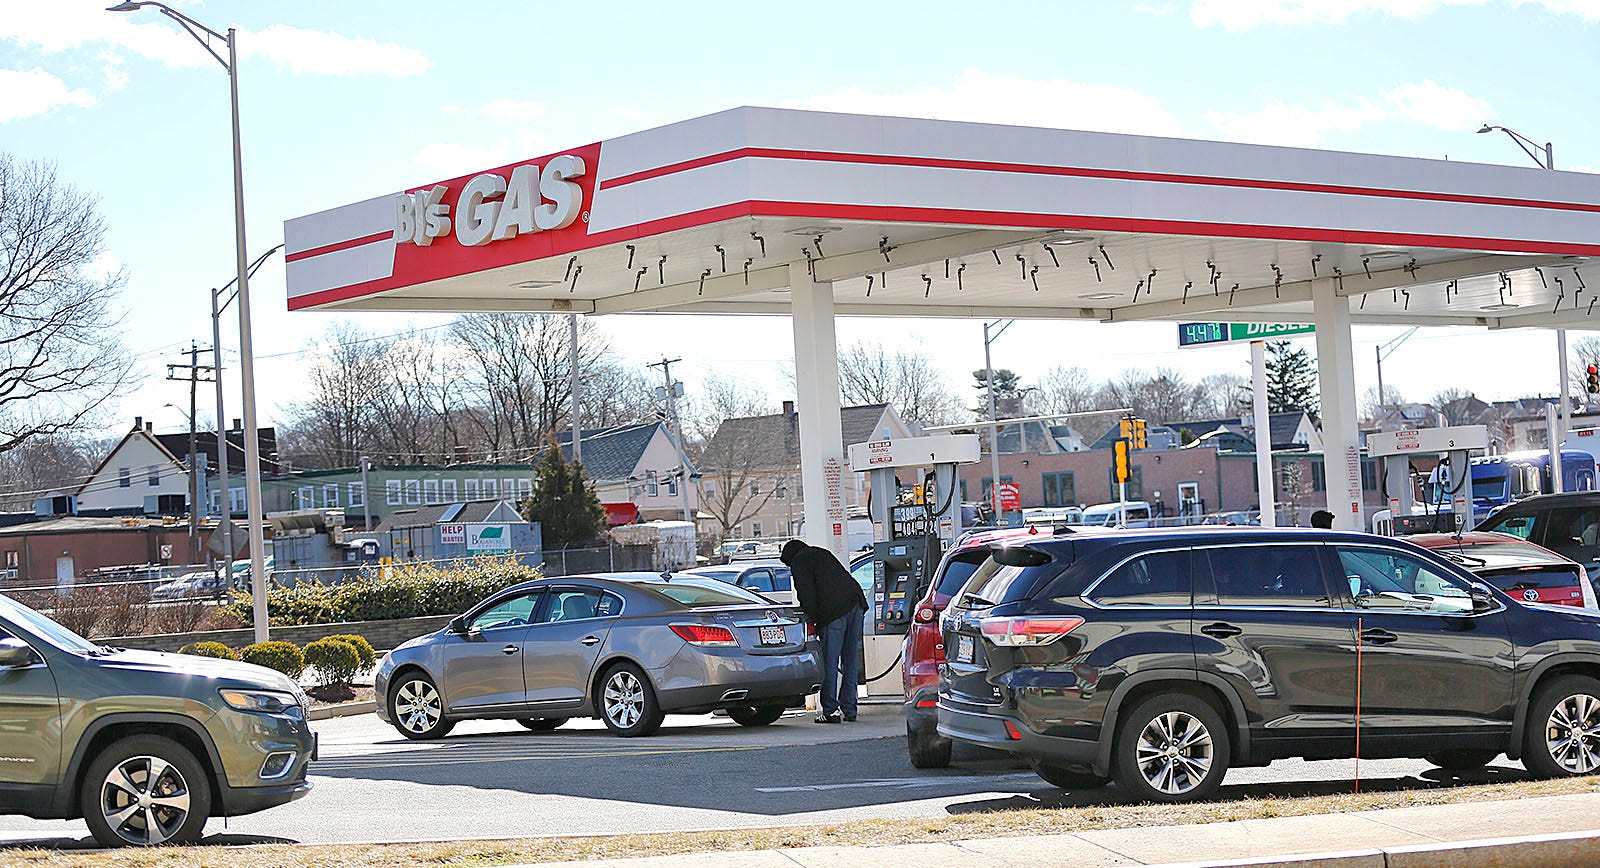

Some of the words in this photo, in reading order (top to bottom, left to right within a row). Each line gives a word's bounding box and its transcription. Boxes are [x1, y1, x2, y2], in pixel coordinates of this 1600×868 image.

[455, 155, 586, 246] GAS
[930, 453, 935, 461] 1
[442, 526, 463, 534] HELP
[942, 541, 947, 549] 1
